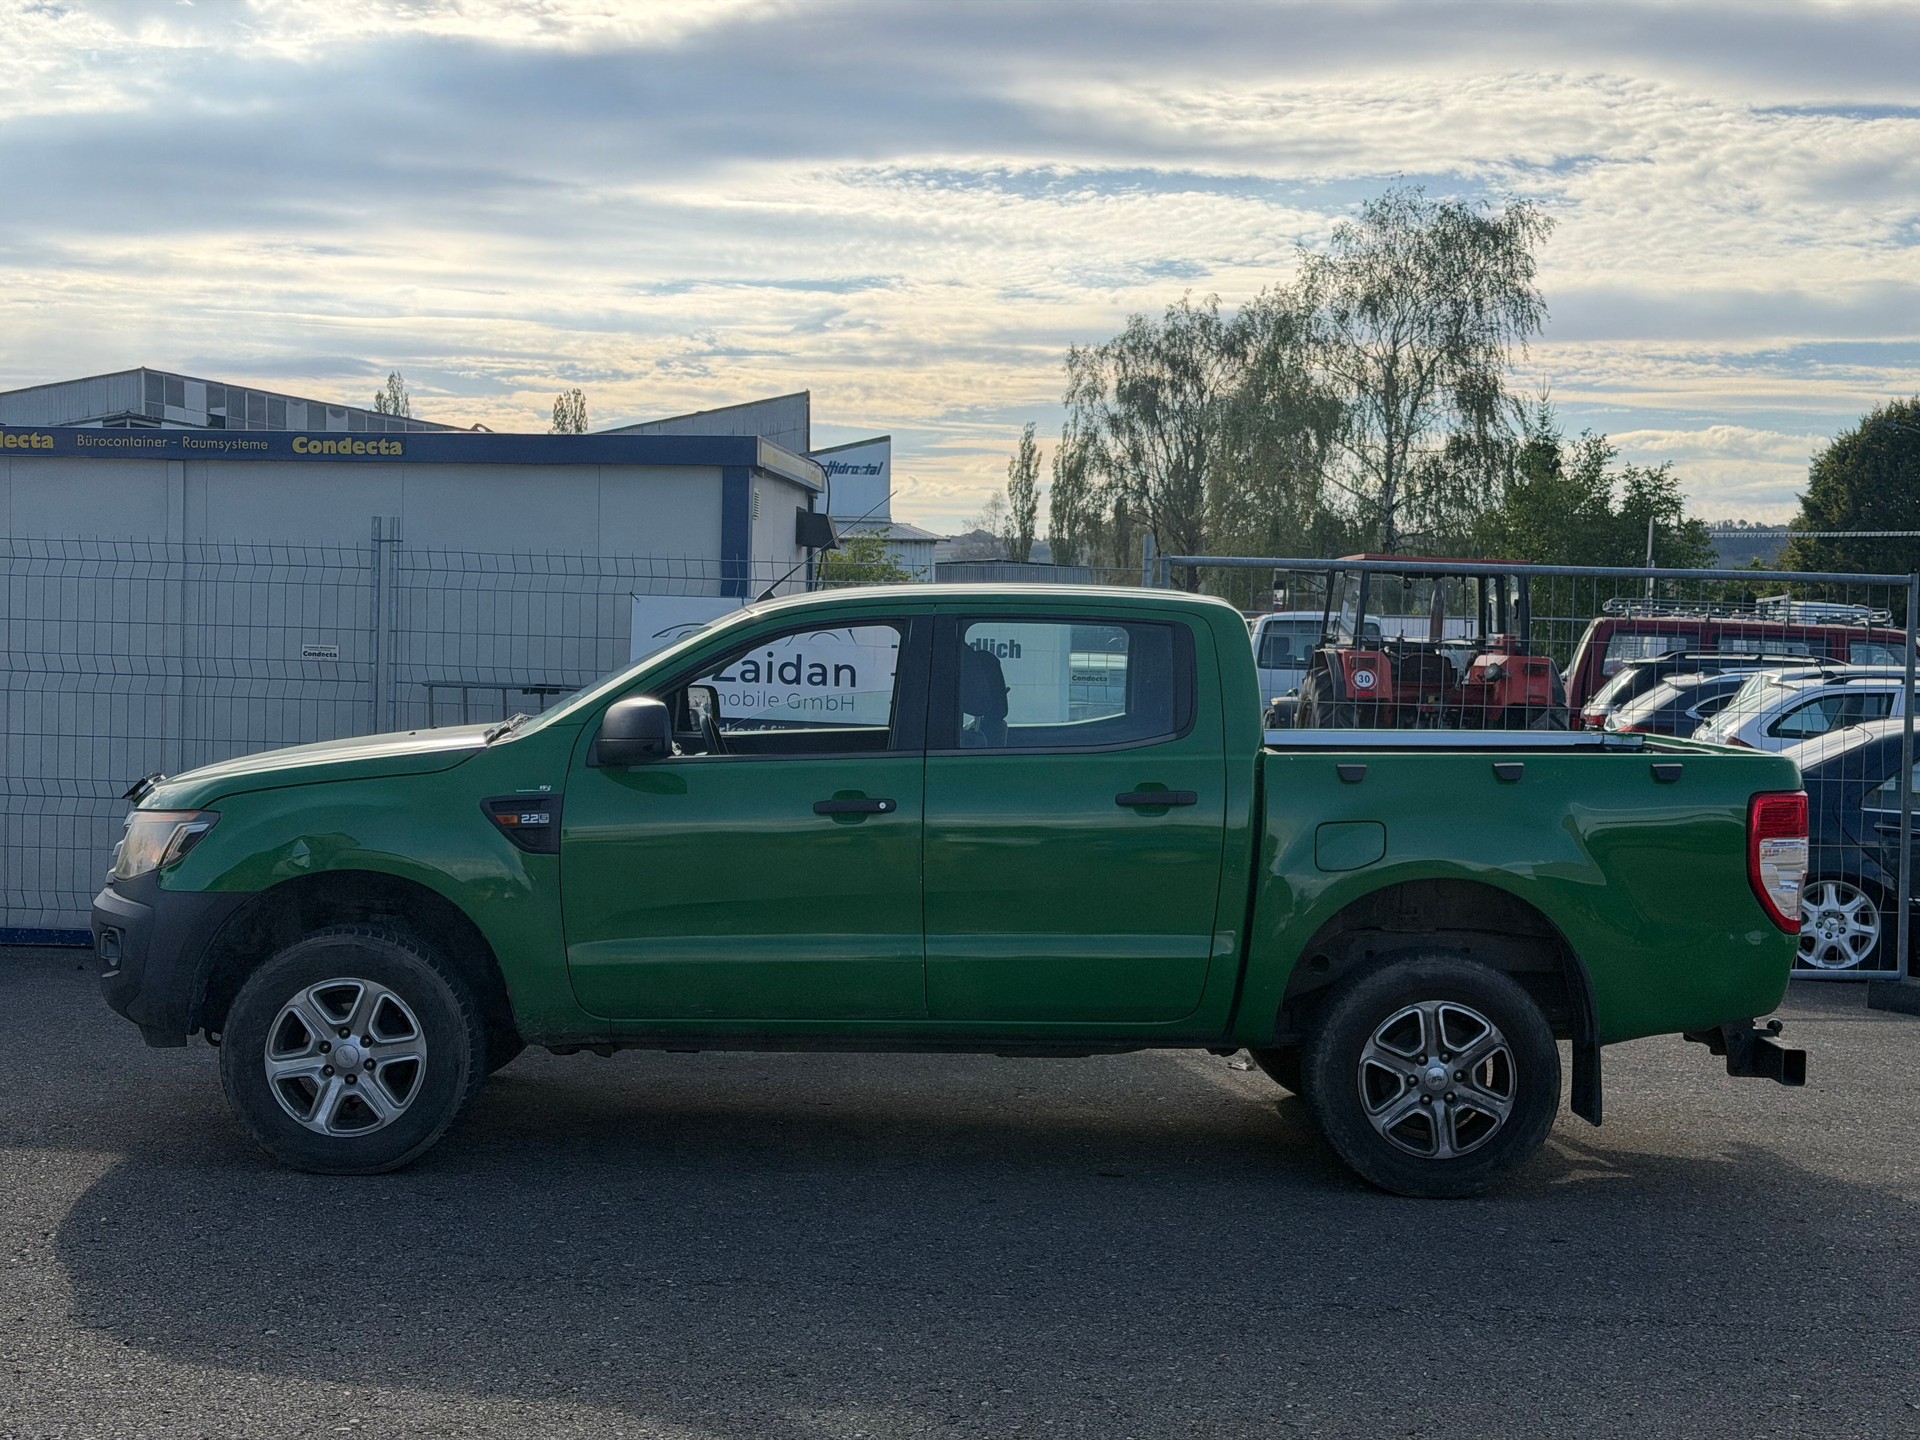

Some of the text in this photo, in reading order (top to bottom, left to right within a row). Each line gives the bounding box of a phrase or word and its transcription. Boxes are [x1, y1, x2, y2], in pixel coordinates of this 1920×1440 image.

[77, 433, 168, 447] Bürocontainer
[182, 436, 268, 452] Raumsysteme
[292, 437, 403, 455] Condecta
[1358, 674, 1370, 683] 30
[786, 692, 855, 712] GmbH
